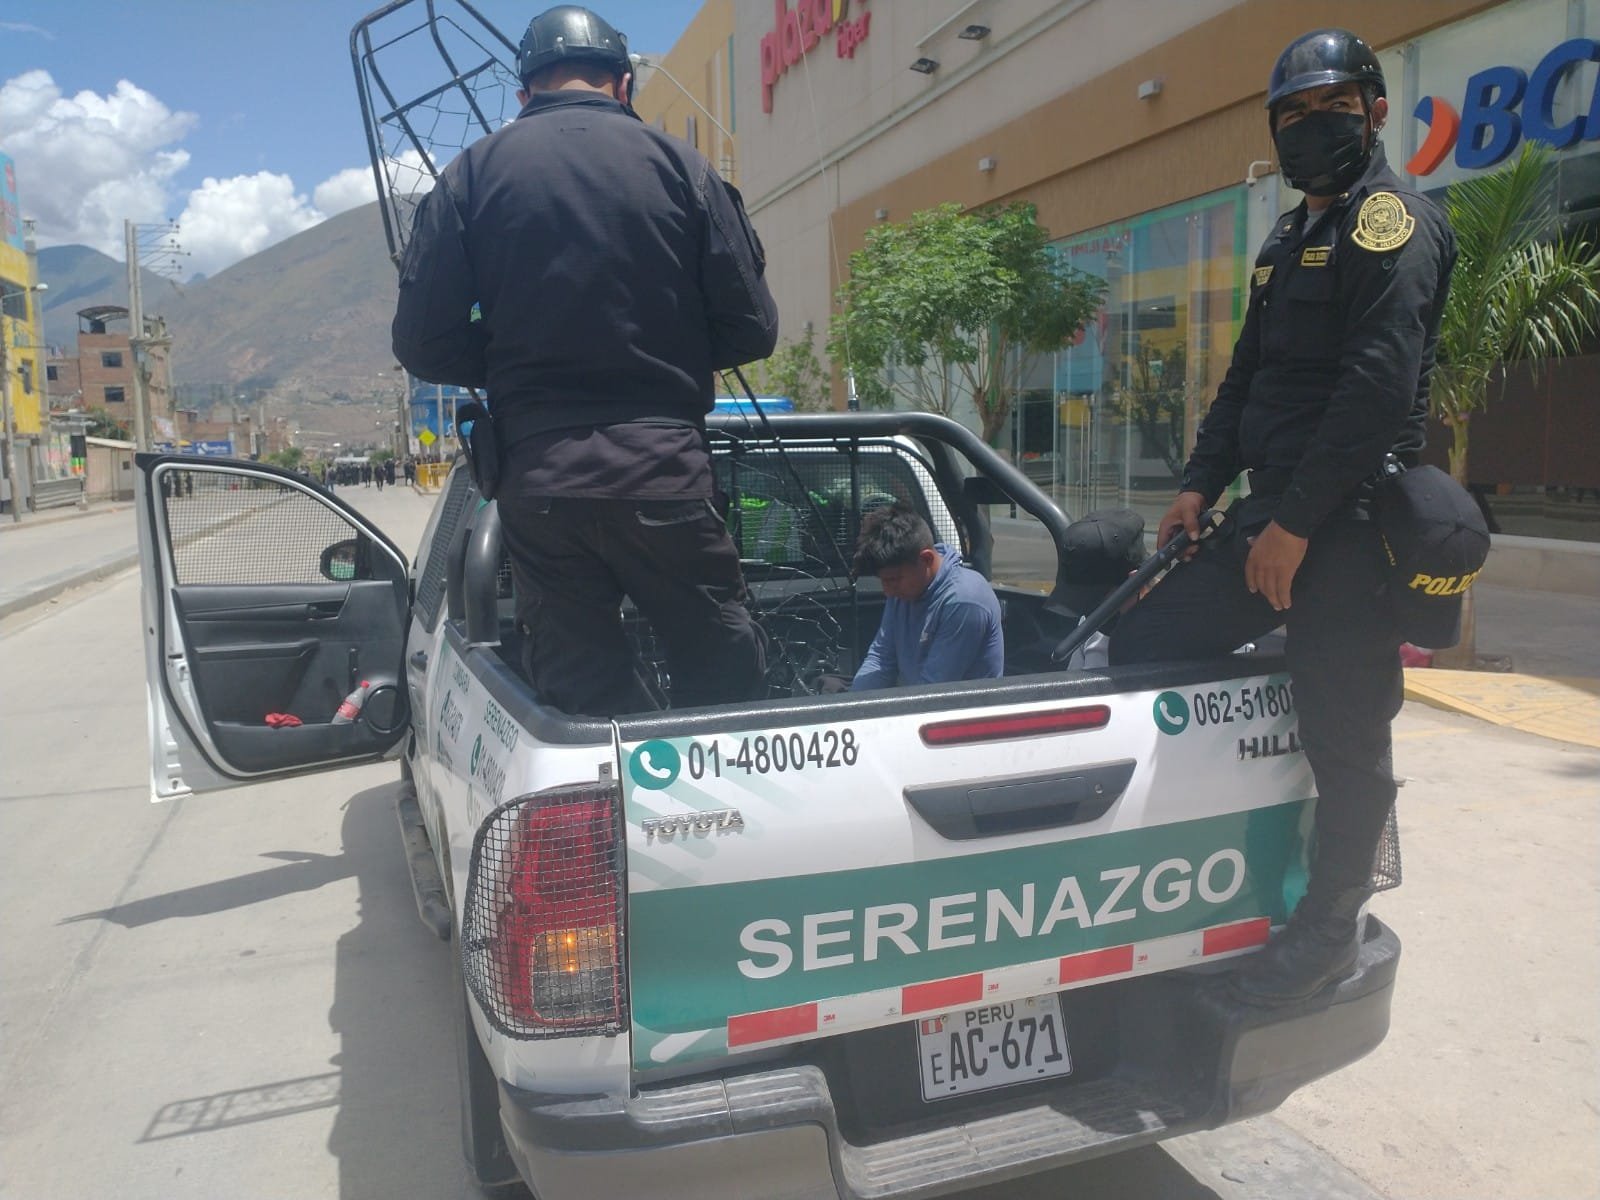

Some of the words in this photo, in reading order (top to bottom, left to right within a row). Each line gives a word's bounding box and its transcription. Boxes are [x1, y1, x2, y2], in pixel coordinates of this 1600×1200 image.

[483, 699, 519, 753] SERENAZGO
[1193, 683, 1296, 727] 062-5180
[688, 728, 858, 780] 01-4800428
[641, 808, 745, 838] TOYOTA
[736, 848, 1246, 980] SERENAZGO
[965, 1003, 1015, 1028] PERU
